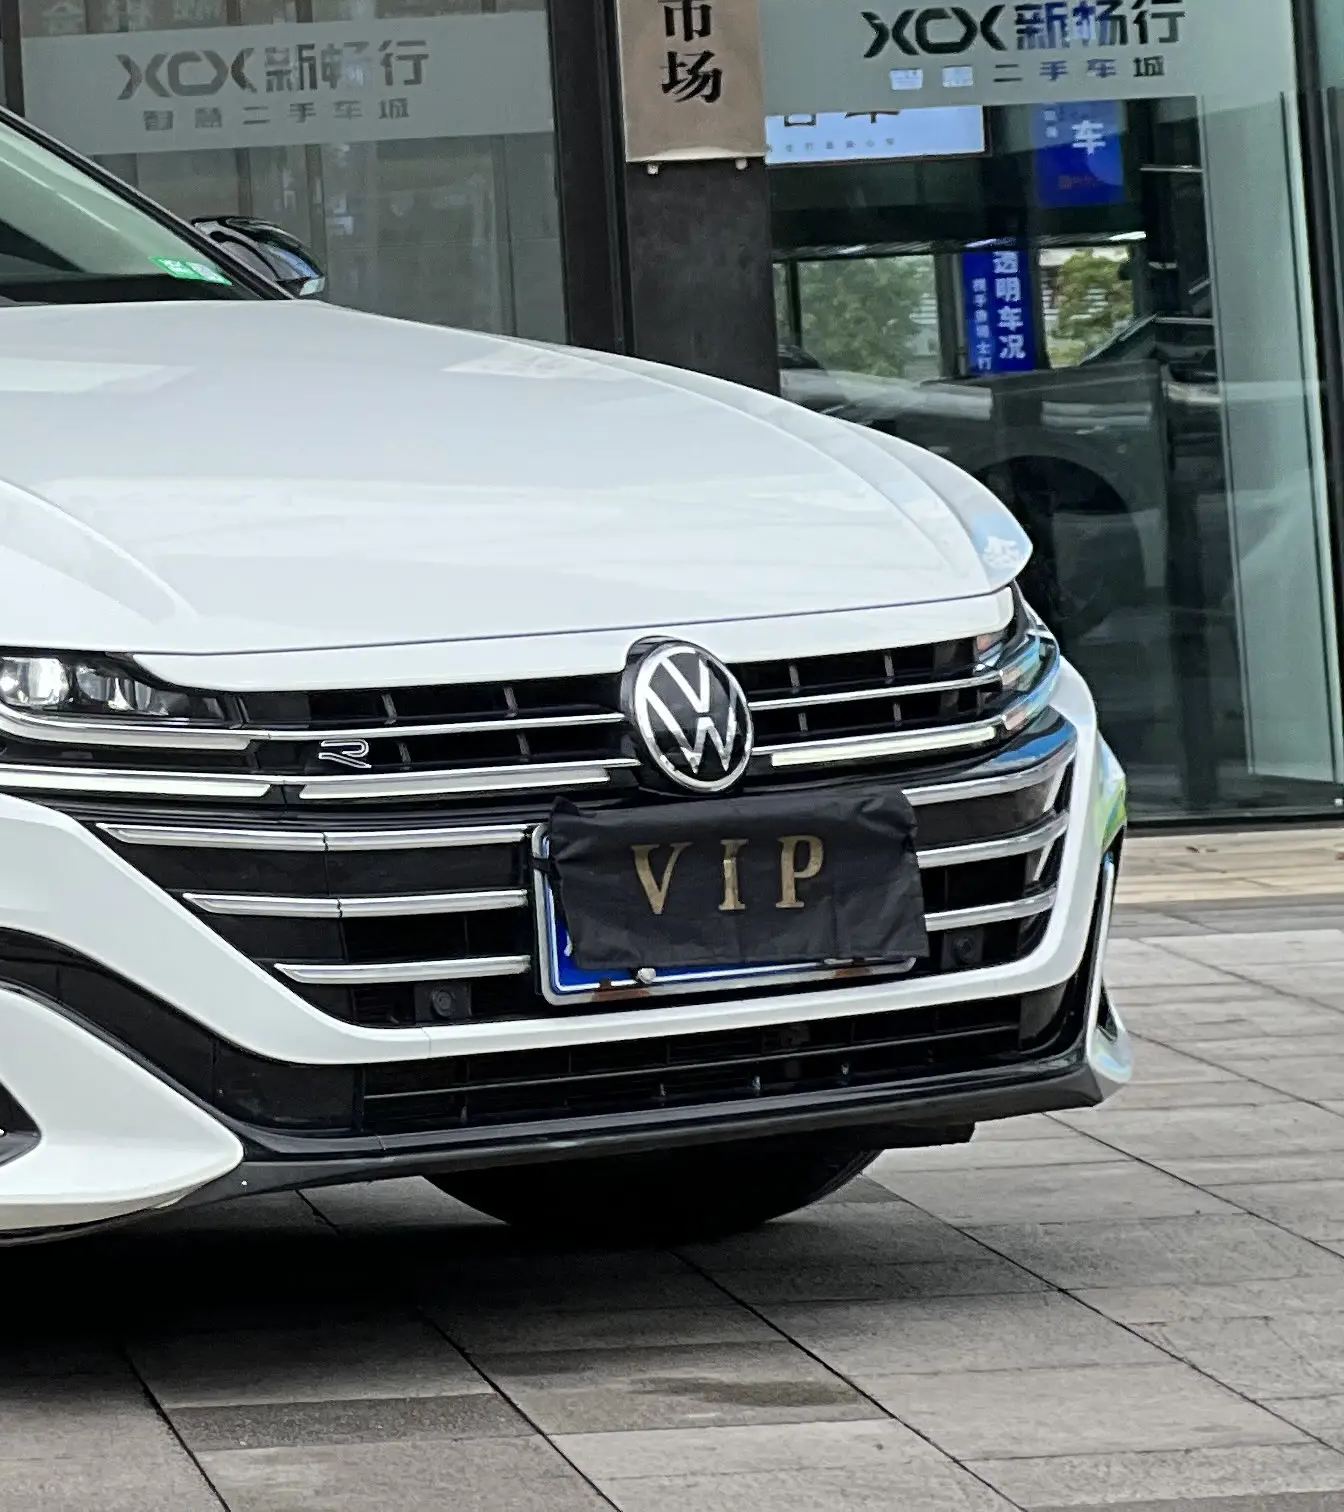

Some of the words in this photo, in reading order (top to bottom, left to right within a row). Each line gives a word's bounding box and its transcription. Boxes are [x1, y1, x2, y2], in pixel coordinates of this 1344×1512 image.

[265, 39, 430, 92] 新畅行
[890, 55, 1166, 91] 二手车城
[631, 833, 826, 916] VIP
